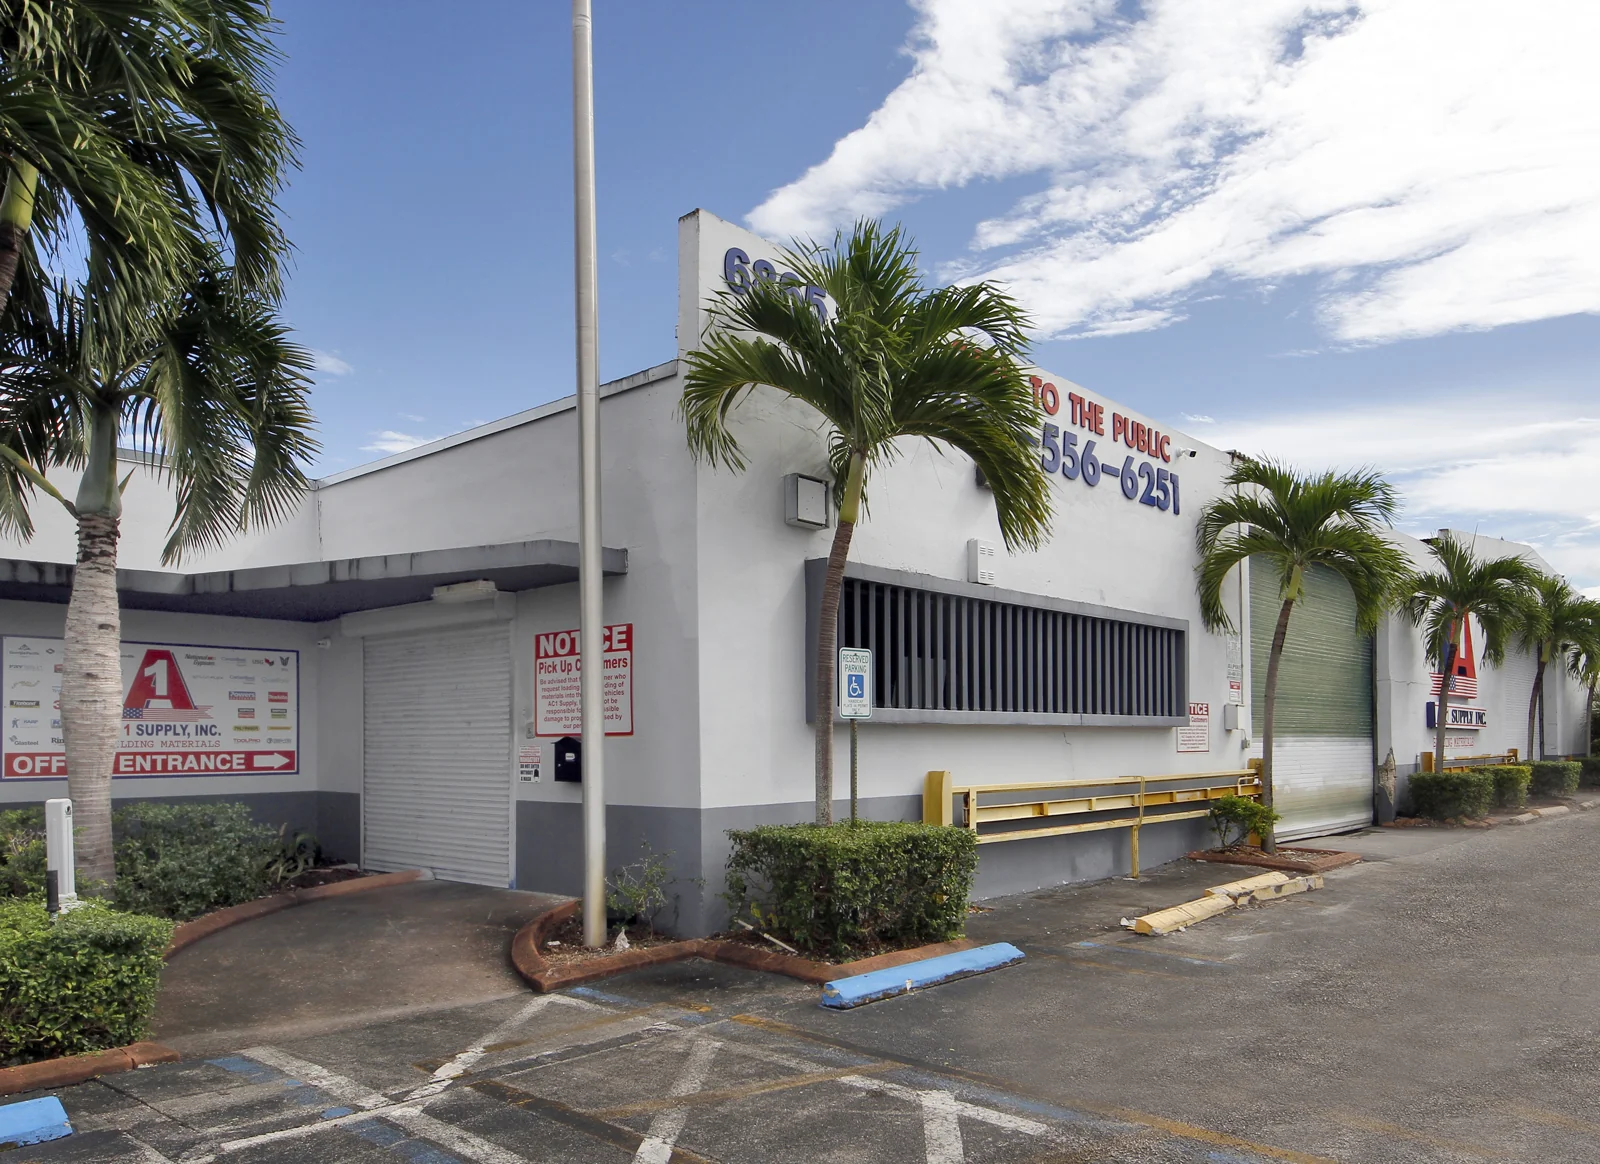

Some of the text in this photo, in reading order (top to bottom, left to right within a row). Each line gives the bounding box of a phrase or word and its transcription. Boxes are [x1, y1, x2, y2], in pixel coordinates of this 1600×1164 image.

[1029, 375, 1059, 416] TO
[1069, 392, 1105, 436] THE
[1112, 412, 1171, 463] PUBLIC
[539, 625, 628, 657] NOTCE
[843, 653, 869, 664] RESERVED
[539, 661, 557, 674] Pick
[561, 660, 572, 675] Up
[845, 664, 867, 673] PARKING
[548, 677, 567, 685] advised
[53, 700, 60, 709] 3
[1190, 704, 1208, 714] TICE
[546, 707, 575, 715] responsible
[1452, 709, 1487, 725] SUPPLY INC.
[136, 724, 190, 738] SUPPLY,
[195, 724, 221, 736] INC.
[117, 740, 220, 748] LDING MATERIALS
[13, 754, 246, 774] OFF ENTRANCE
